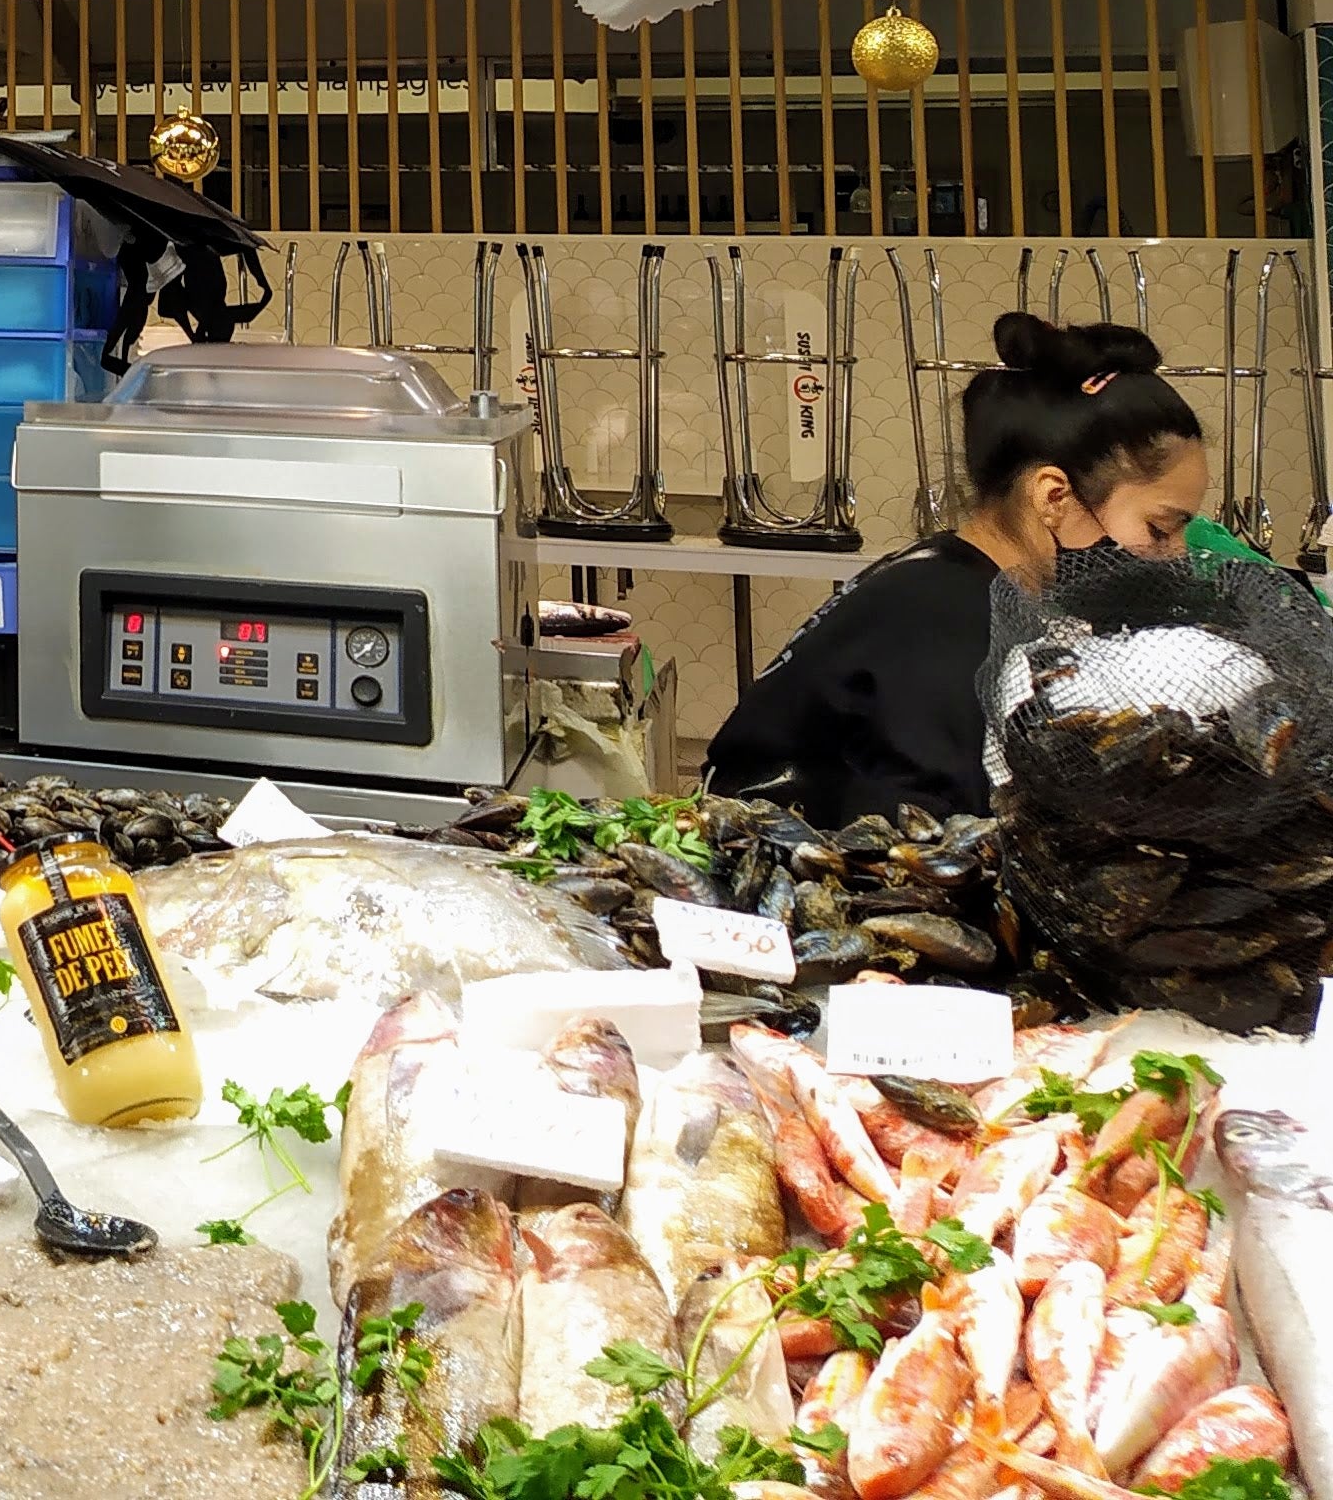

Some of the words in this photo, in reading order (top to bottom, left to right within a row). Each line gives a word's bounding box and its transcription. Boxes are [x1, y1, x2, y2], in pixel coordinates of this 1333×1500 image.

[800, 404, 815, 439] KING
[55, 961, 90, 998] DE
[84, 948, 140, 986] PEIX
